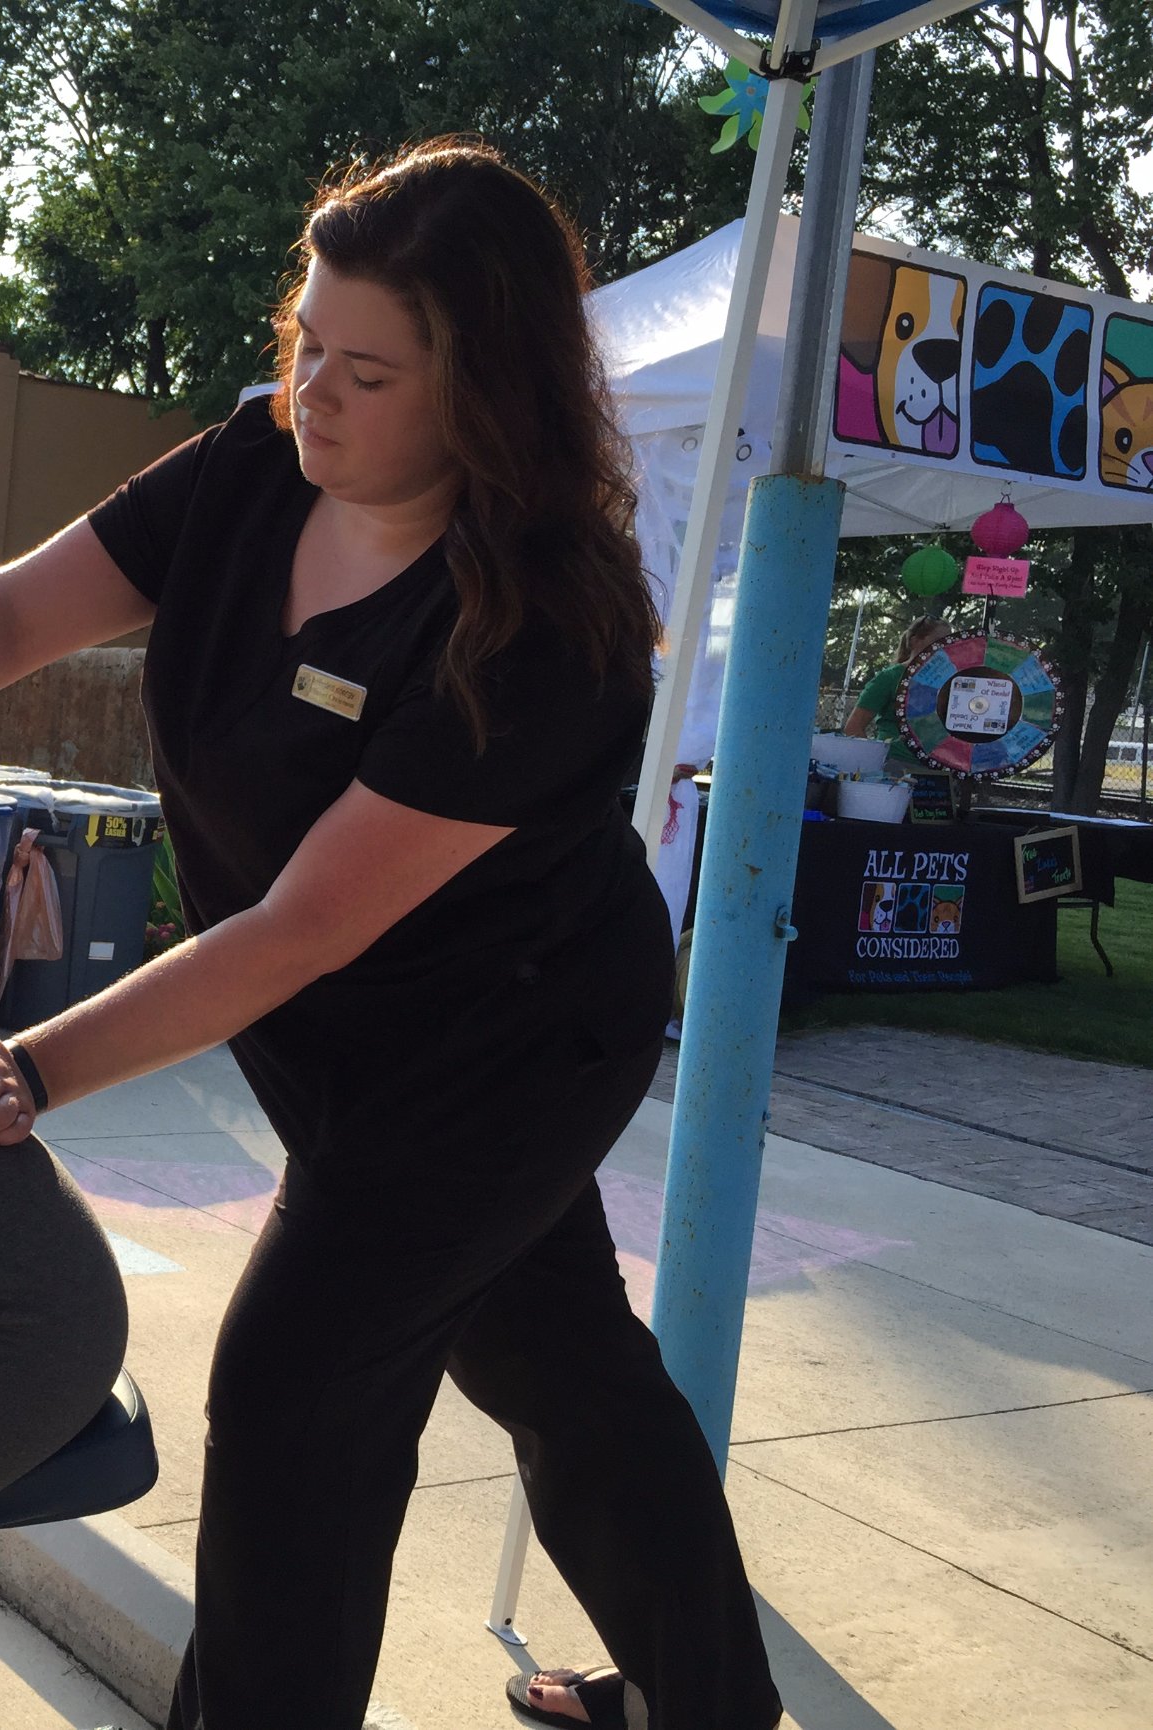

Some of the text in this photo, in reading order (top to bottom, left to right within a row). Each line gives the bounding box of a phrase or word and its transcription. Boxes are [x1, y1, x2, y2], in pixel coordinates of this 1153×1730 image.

[106, 815, 127, 829] 50%
[104, 828, 127, 837] EASIER
[863, 850, 969, 882] ALL PETS
[856, 937, 960, 960] CONSIDERED
